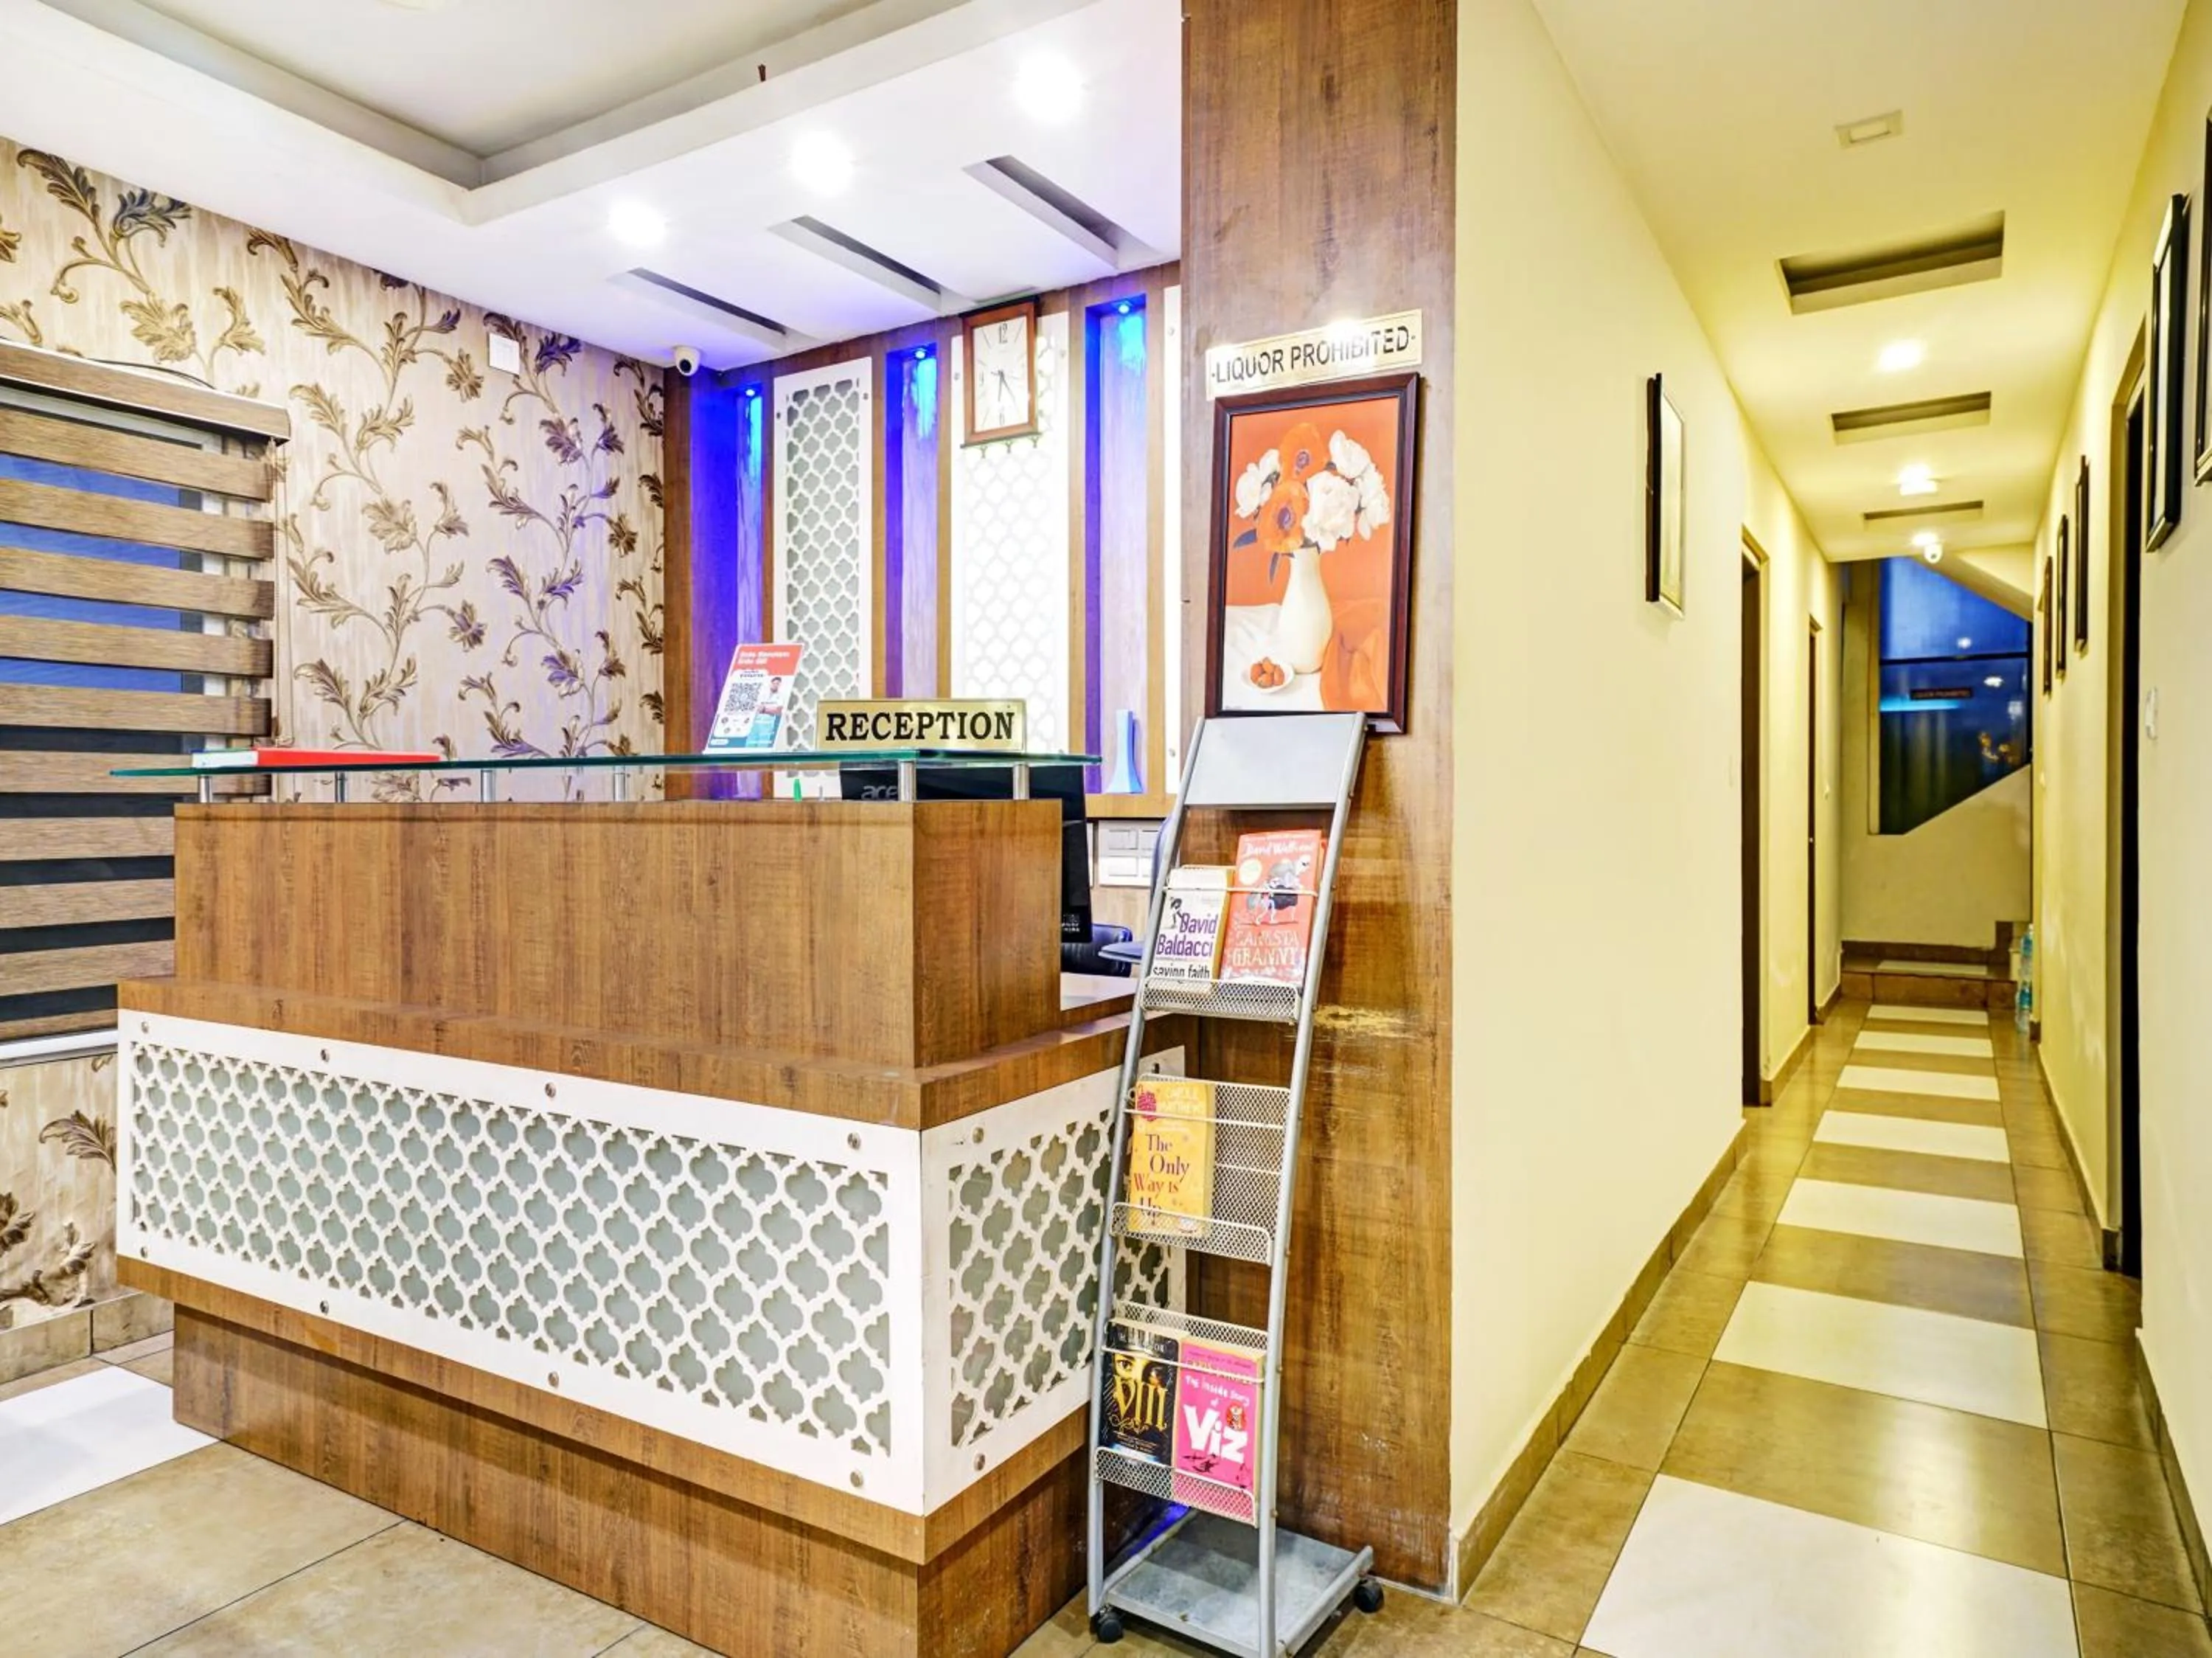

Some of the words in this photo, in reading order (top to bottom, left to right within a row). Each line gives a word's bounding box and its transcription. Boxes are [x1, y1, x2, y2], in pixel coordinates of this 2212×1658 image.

[1216, 349, 1284, 383] LIQUOR
[1291, 325, 1409, 370] PROHIBITED
[825, 711, 1015, 740] RECEPTION
[861, 785, 898, 801] ace
[1180, 912, 1218, 934] David
[1155, 933, 1214, 957] Baldacci
[1188, 964, 1211, 979] faith
[1145, 1134, 1172, 1152] The
[1150, 1155, 1189, 1183] Only
[1133, 1173, 1164, 1199] Way
[1169, 1180, 1179, 1193] is
[1183, 1404, 1248, 1464] Viz
